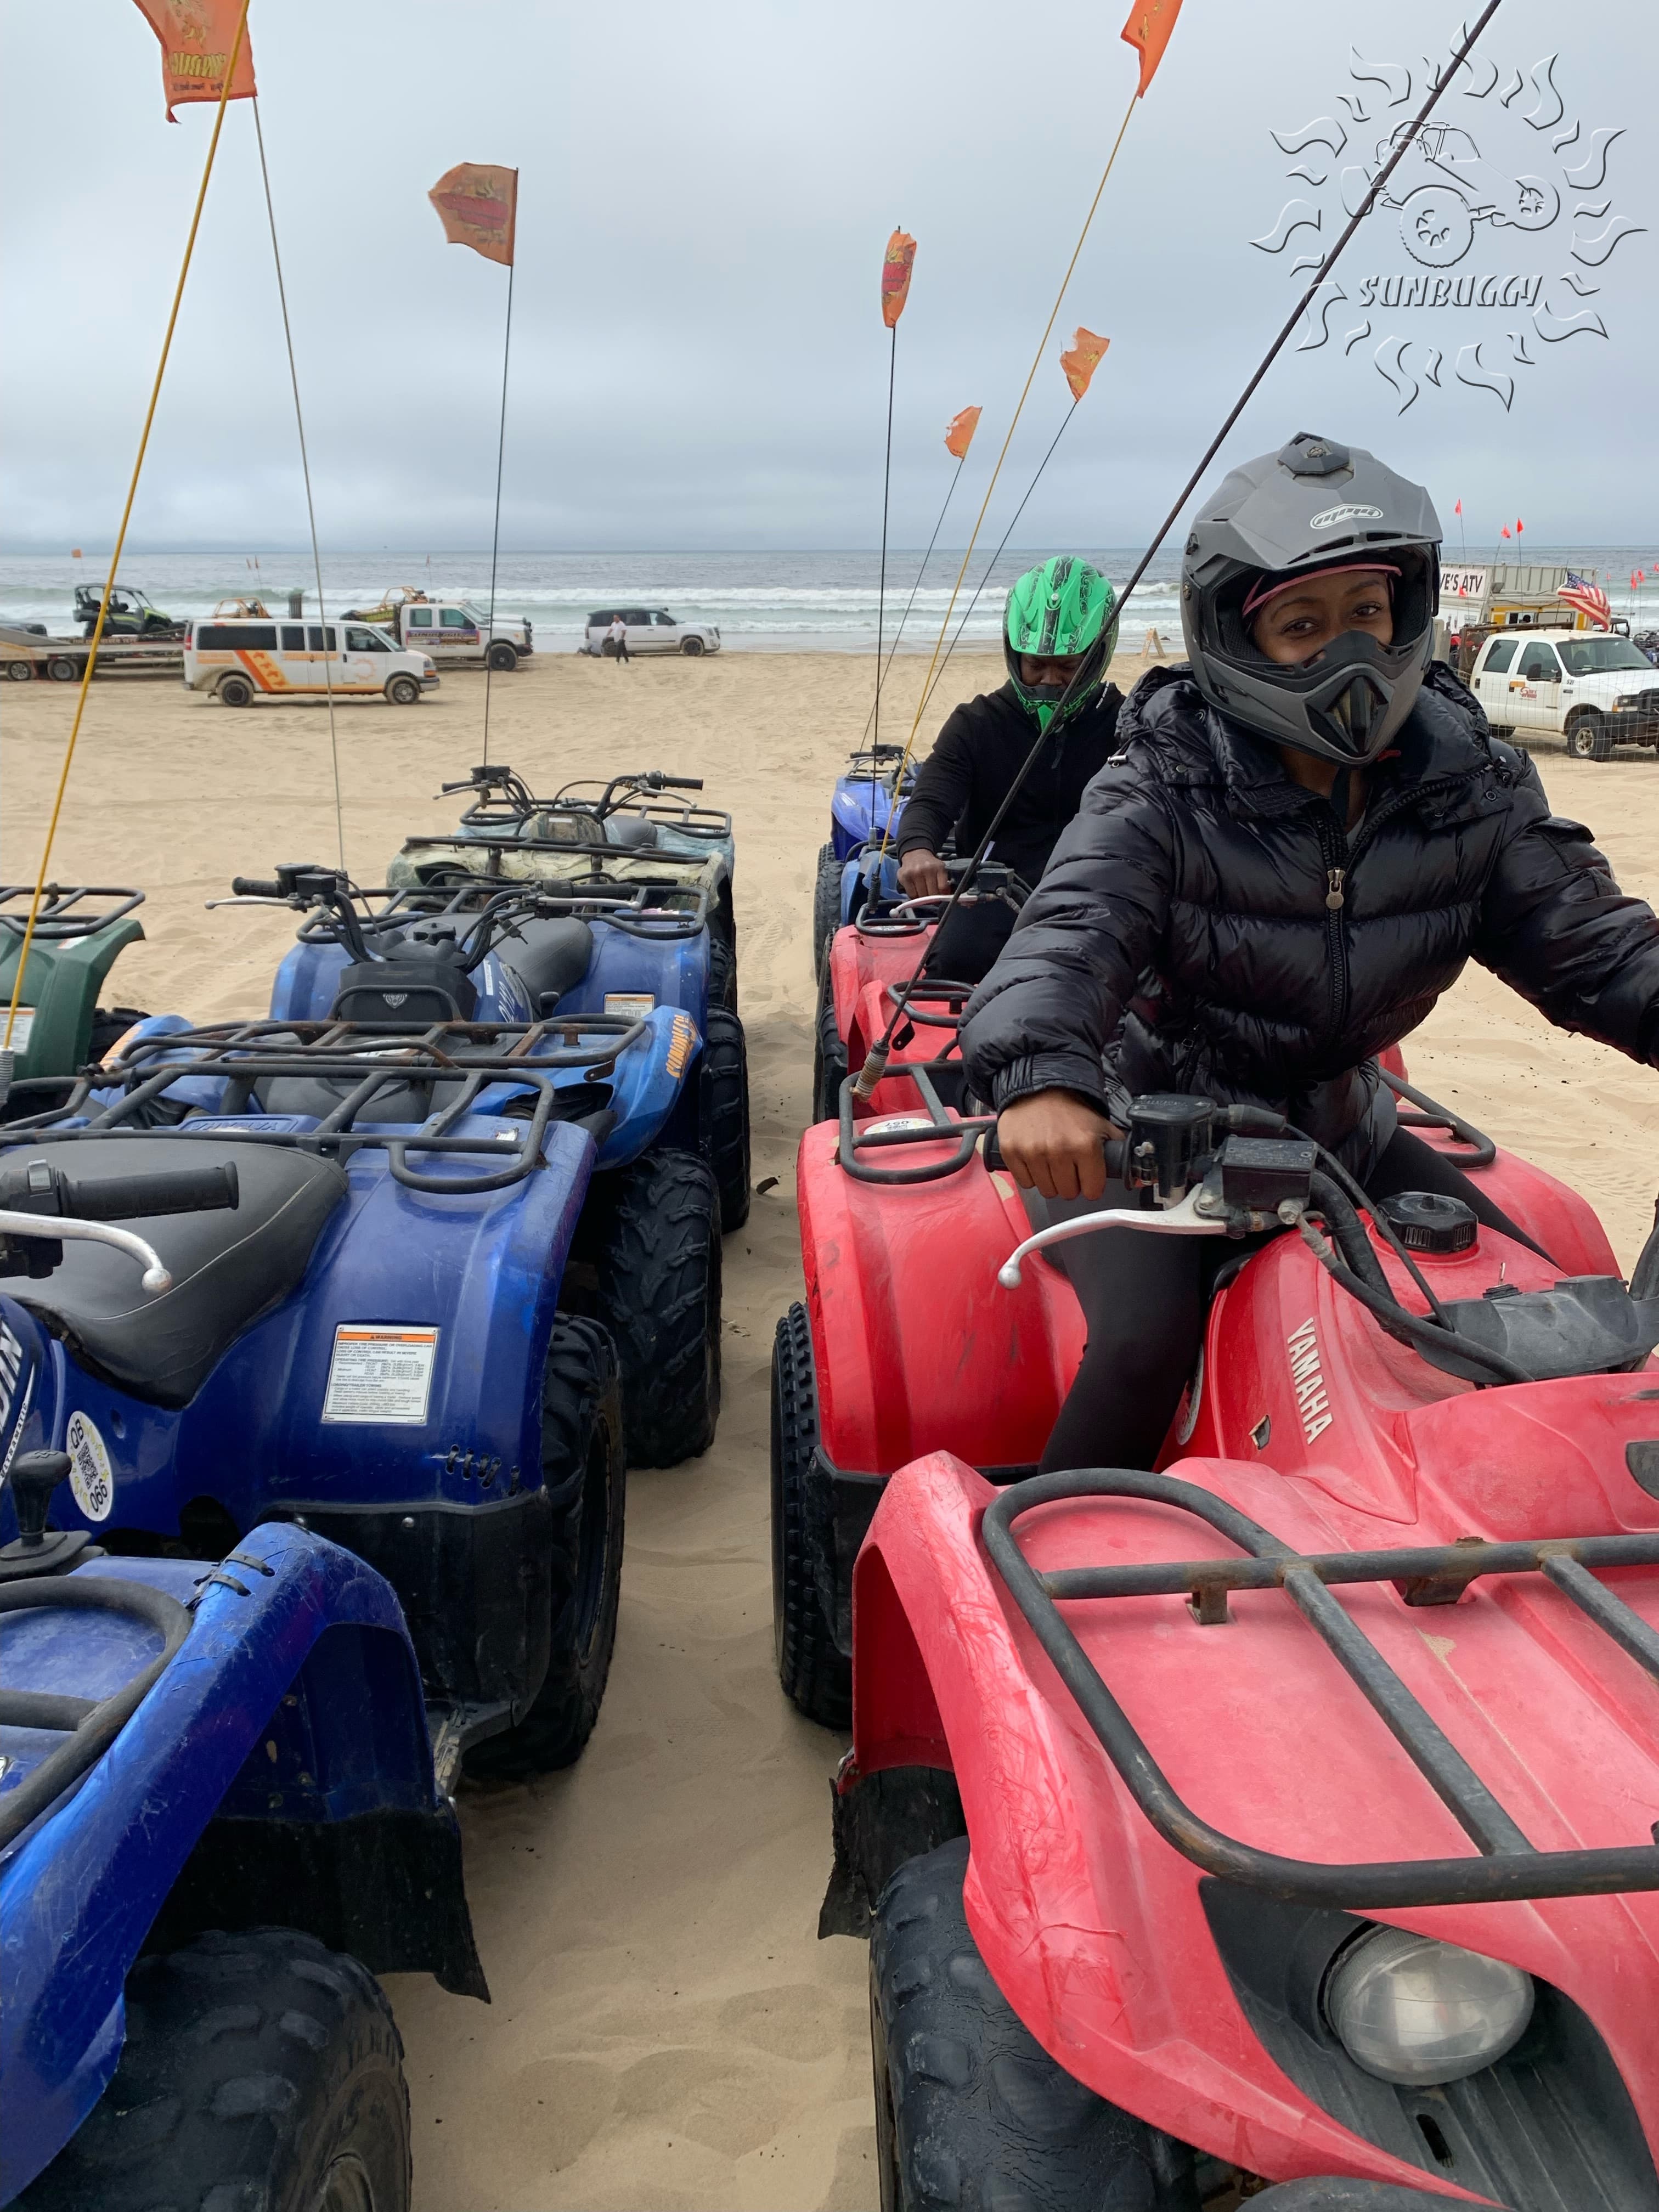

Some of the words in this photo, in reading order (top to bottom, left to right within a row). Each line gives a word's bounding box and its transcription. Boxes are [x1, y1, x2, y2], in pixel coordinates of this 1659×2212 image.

[1462, 574, 1483, 592] ATV
[1287, 1317, 1333, 1445] YAMAHA
[1, 1402, 27, 1479] ULTRAMATIC
[89, 1478, 108, 1513] 066
